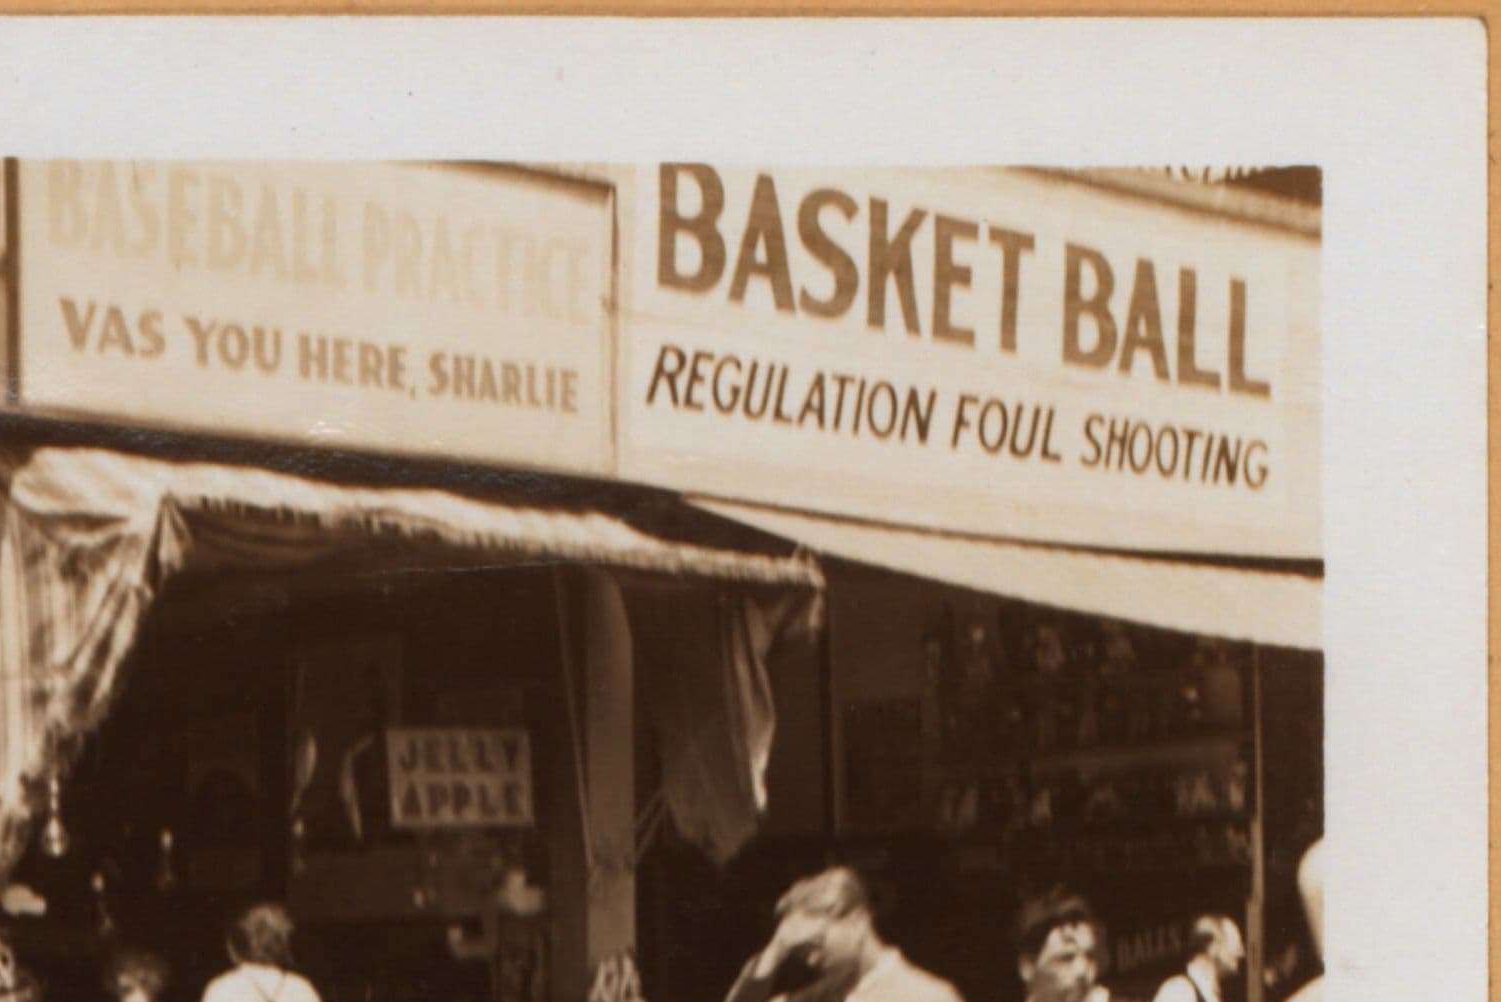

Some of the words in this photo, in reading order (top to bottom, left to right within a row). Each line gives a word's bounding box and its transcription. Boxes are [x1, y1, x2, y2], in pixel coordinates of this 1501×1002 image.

[47, 160, 347, 291] BASEBALL
[361, 198, 596, 324] PRACTICE
[657, 162, 1035, 353] BASKET
[1062, 242, 1271, 398] BALL
[59, 298, 166, 360] VAS
[184, 316, 282, 375] YOU
[299, 332, 417, 401] HERE,
[428, 350, 579, 415] SHARLIE
[646, 344, 937, 446] REGULATION
[953, 395, 1062, 463] FOUL
[1081, 414, 1269, 492] SHOOTING
[399, 734, 518, 772] JELLY
[401, 783, 521, 818] APPLE
